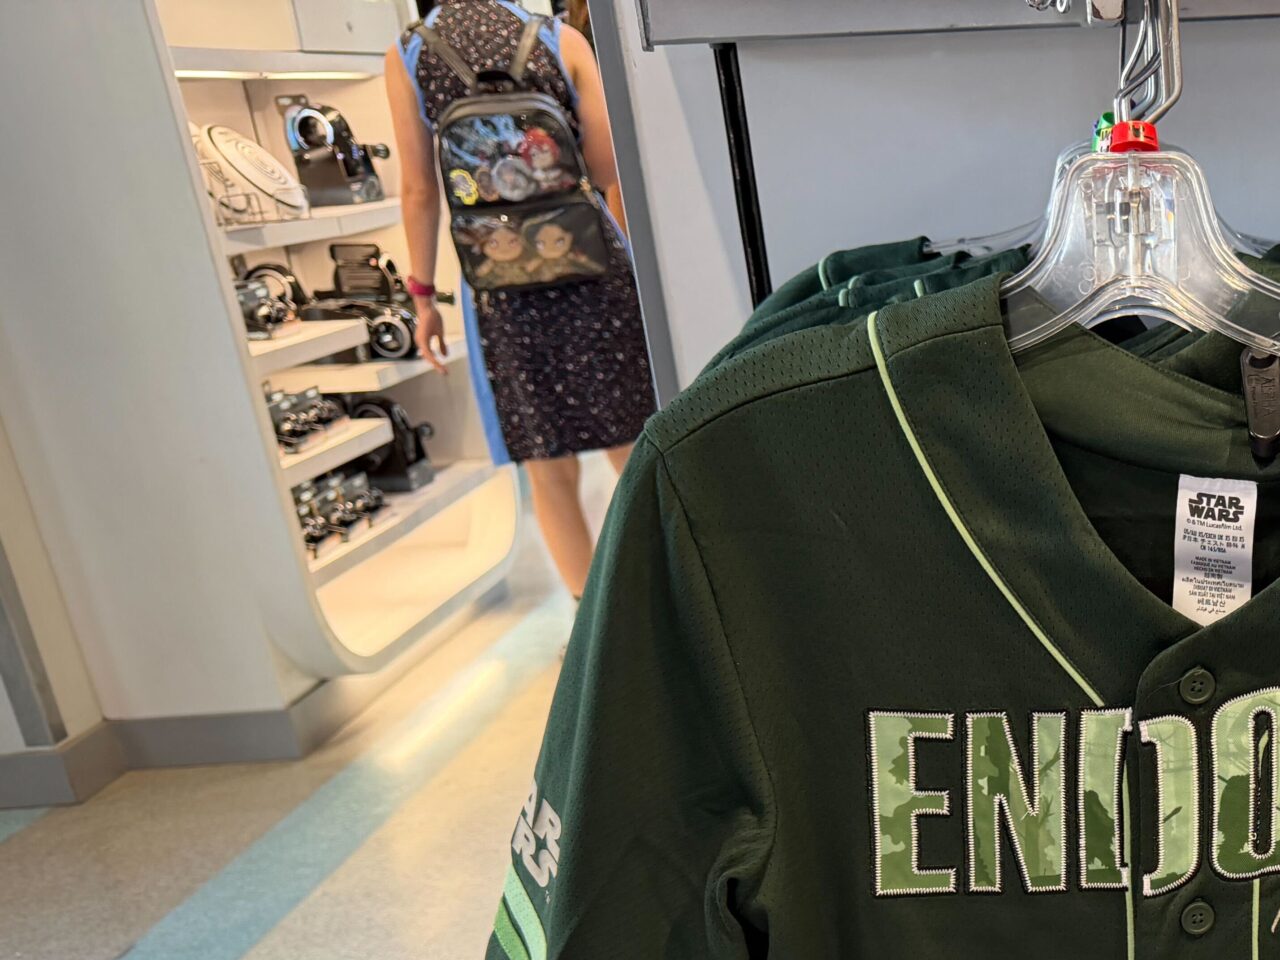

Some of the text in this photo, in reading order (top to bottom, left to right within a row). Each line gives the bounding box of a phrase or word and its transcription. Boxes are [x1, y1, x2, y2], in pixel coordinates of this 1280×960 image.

[1188, 492, 1245, 510] STAR
[1188, 504, 1245, 523] WARS
[1206, 522, 1232, 530] Lucasfilm
